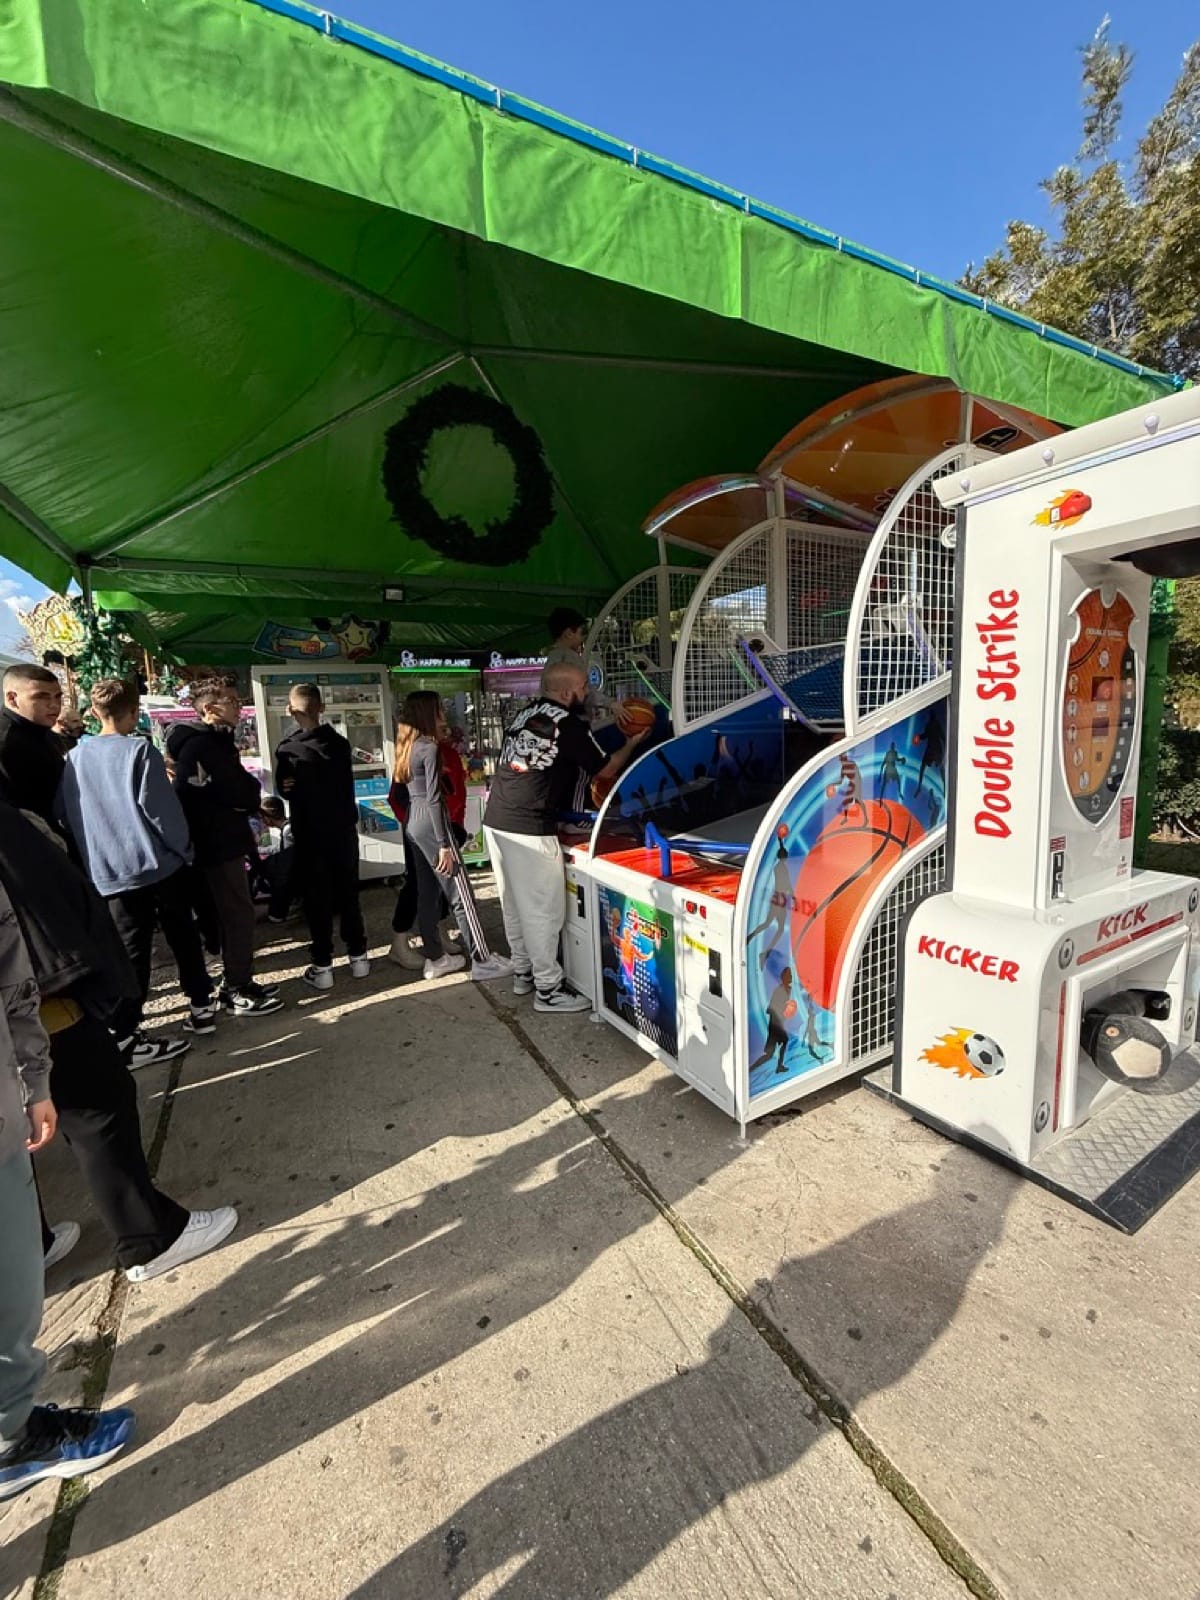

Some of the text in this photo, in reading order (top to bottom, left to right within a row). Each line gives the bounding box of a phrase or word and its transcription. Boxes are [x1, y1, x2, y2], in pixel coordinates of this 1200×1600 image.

[419, 658, 472, 667] HAPPY PLANET
[505, 656, 549, 666] HAPPY PLAN
[971, 588, 1021, 839] Double Strike
[1096, 902, 1150, 942] KICK
[917, 935, 1020, 983] KICKER
